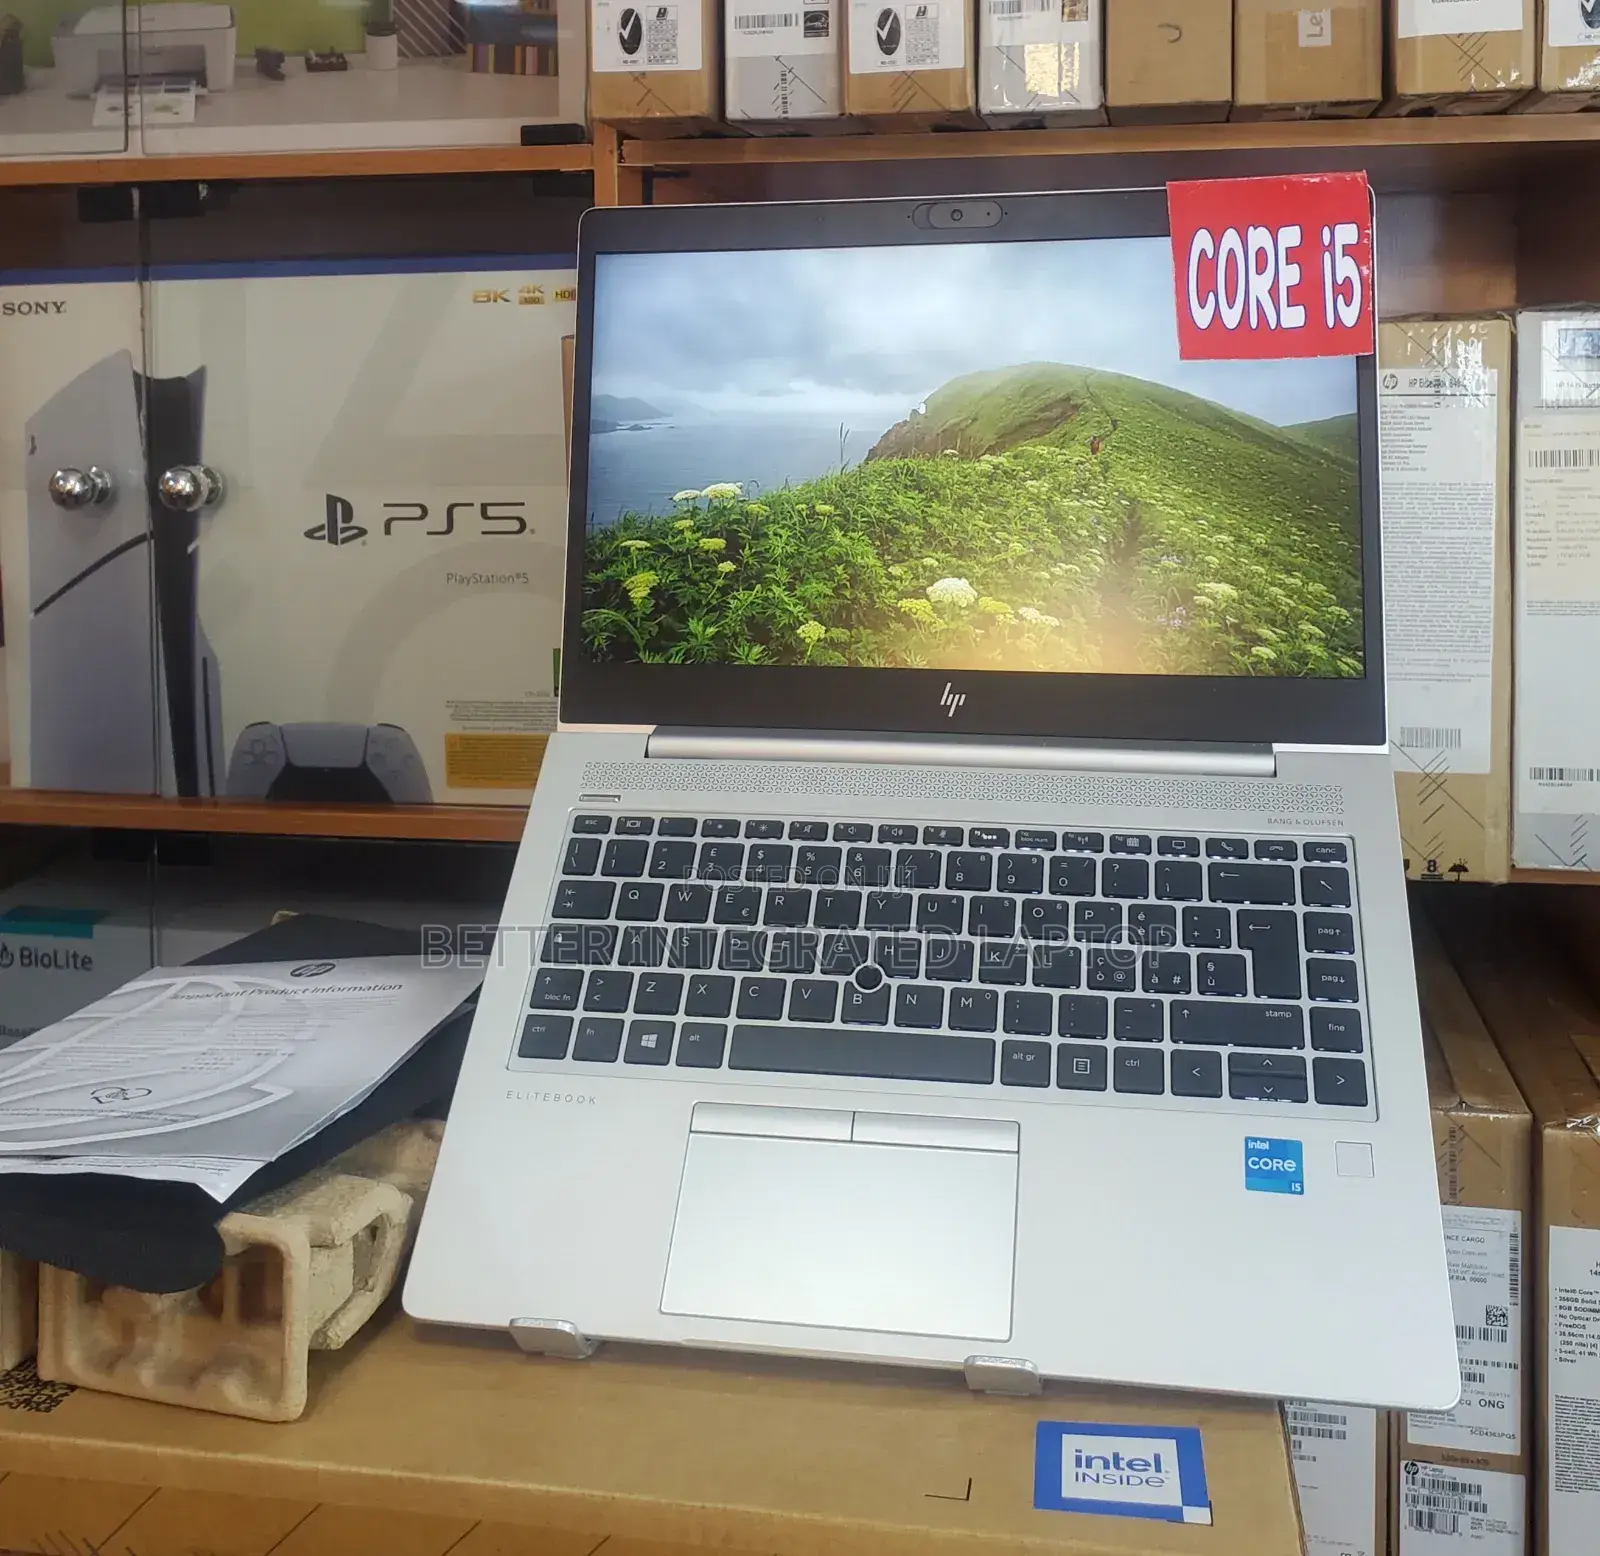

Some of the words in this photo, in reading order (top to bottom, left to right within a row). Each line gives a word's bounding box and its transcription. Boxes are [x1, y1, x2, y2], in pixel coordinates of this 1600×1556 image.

[1187, 224, 1306, 331] CORE
[1321, 222, 1362, 330] i5
[472, 288, 511, 304] 8K
[2, 300, 67, 316] SONY
[383, 502, 528, 536] PS5
[940, 682, 966, 718] hp
[1267, 817, 1293, 825] BANG
[1303, 819, 1345, 827] OLUFSEN
[657, 861, 666, 870] 2
[955, 872, 964, 882] 8
[1007, 874, 1016, 884] 9
[628, 889, 640, 900] Q
[677, 891, 693, 902] W
[725, 893, 735, 904] E
[775, 895, 785, 906] R
[824, 897, 833, 908] T
[876, 899, 887, 910] Y
[927, 902, 938, 912] U
[1084, 910, 1095, 921] P
[681, 936, 690, 947] S
[884, 945, 894, 956] H
[19, 946, 94, 972] BioLite
[990, 951, 1000, 962] K
[1113, 971, 1126, 982] @
[249, 986, 310, 997] Product
[309, 983, 404, 995] Information
[645, 981, 656, 993] Z
[696, 983, 708, 994] X
[749, 986, 760, 997] C
[544, 993, 561, 1001] bloc
[801, 988, 812, 999] V
[852, 994, 863, 1005] B
[906, 994, 917, 1005] N
[960, 997, 973, 1008] M
[1265, 1010, 1292, 1019] stamp
[1328, 1023, 1345, 1032] fine
[689, 1033, 700, 1042] alt
[1012, 1052, 1025, 1060] alt
[1026, 1054, 1036, 1062] gr
[1125, 1059, 1140, 1067] ctrl
[506, 1090, 598, 1105] ELITEBOOK
[1248, 1139, 1270, 1151] intel
[1461, 1235, 1485, 1244] CARGO
[1569, 1314, 1592, 1322] Optical
[1558, 1322, 1587, 1330] FreeDOS
[1558, 1356, 1577, 1364] Silver
[1478, 1398, 1505, 1410] ONG
[1074, 1449, 1163, 1473] intel
[1404, 1461, 1419, 1476] hp
